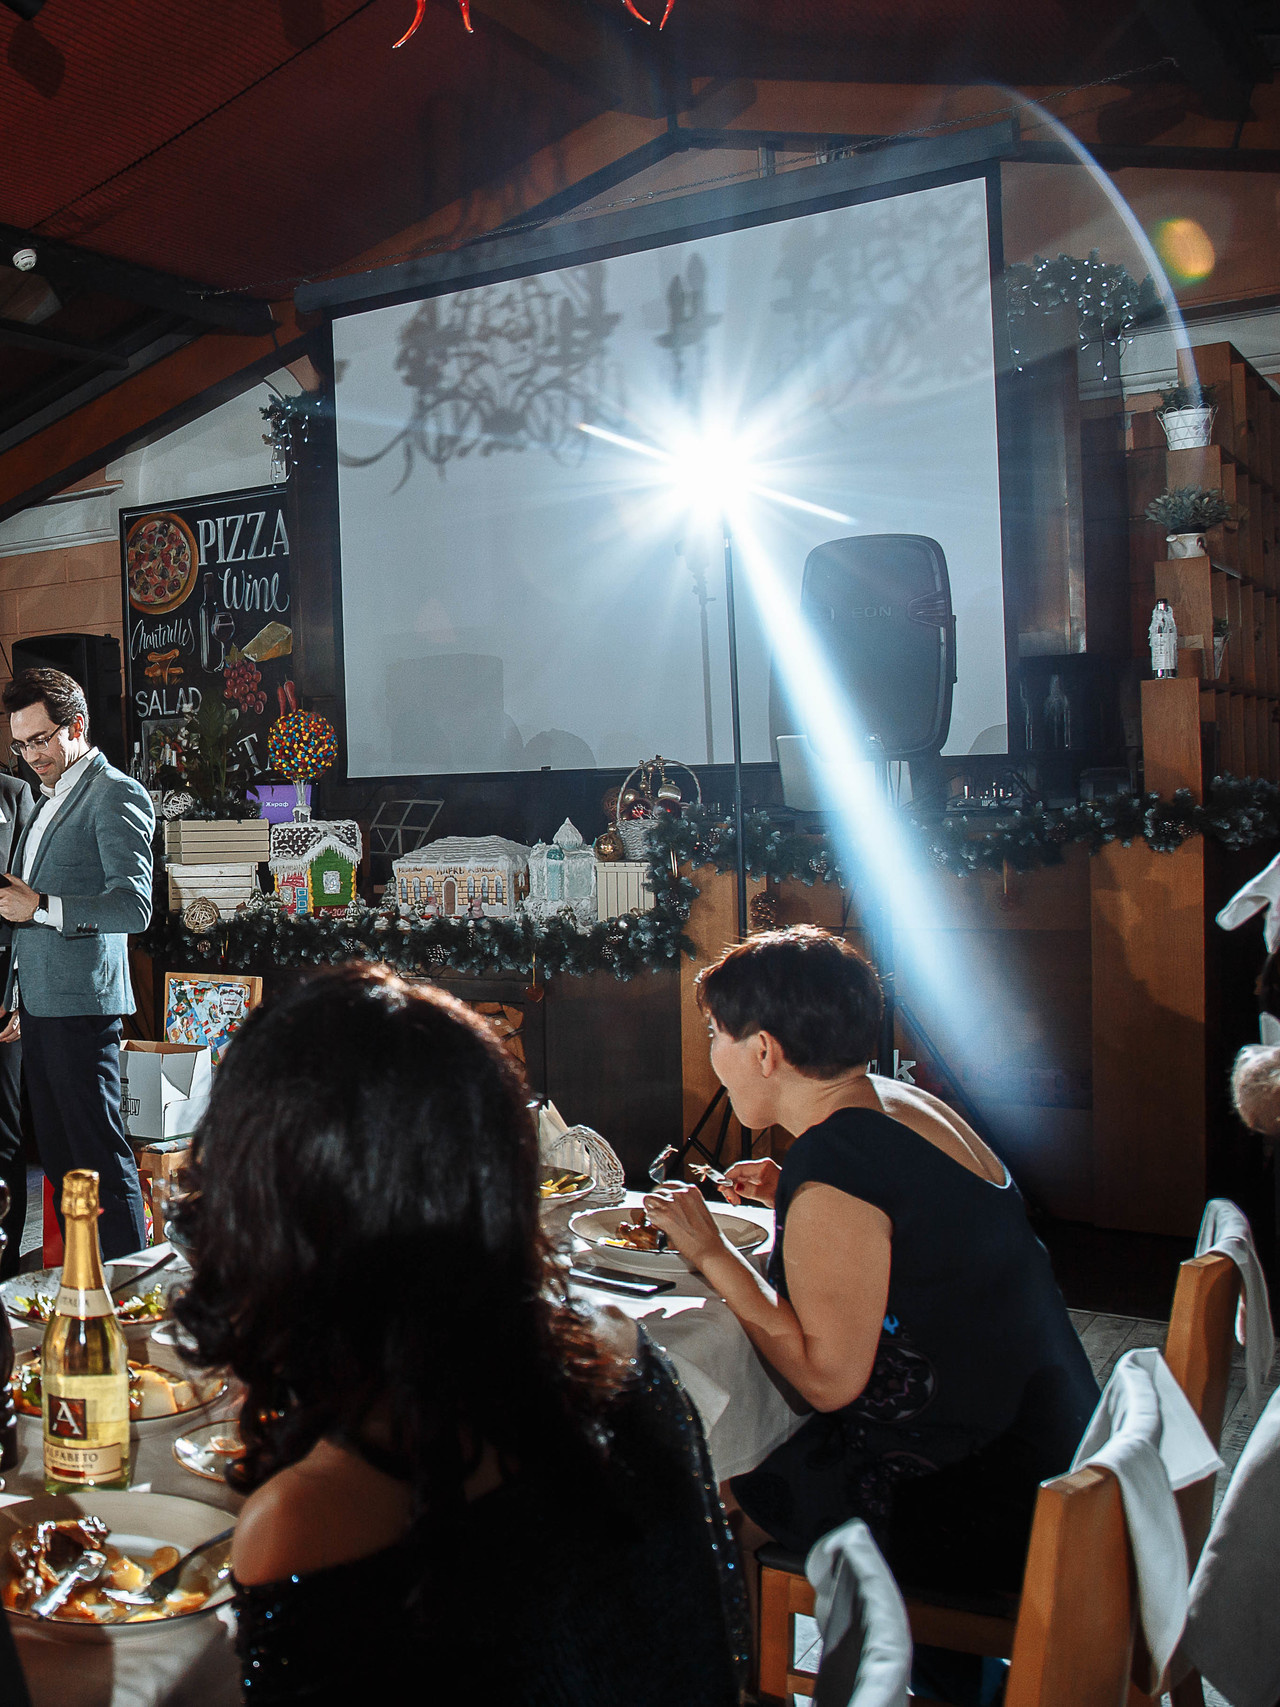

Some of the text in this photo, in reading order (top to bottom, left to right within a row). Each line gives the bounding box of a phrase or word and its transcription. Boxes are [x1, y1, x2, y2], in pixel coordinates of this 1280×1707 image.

[197, 509, 290, 566] PIZZA
[218, 567, 290, 613] Wine
[851, 606, 892, 619] EON
[135, 686, 203, 718] SALAD
[265, 801, 289, 809] Жираф
[51, 1399, 83, 1436] A
